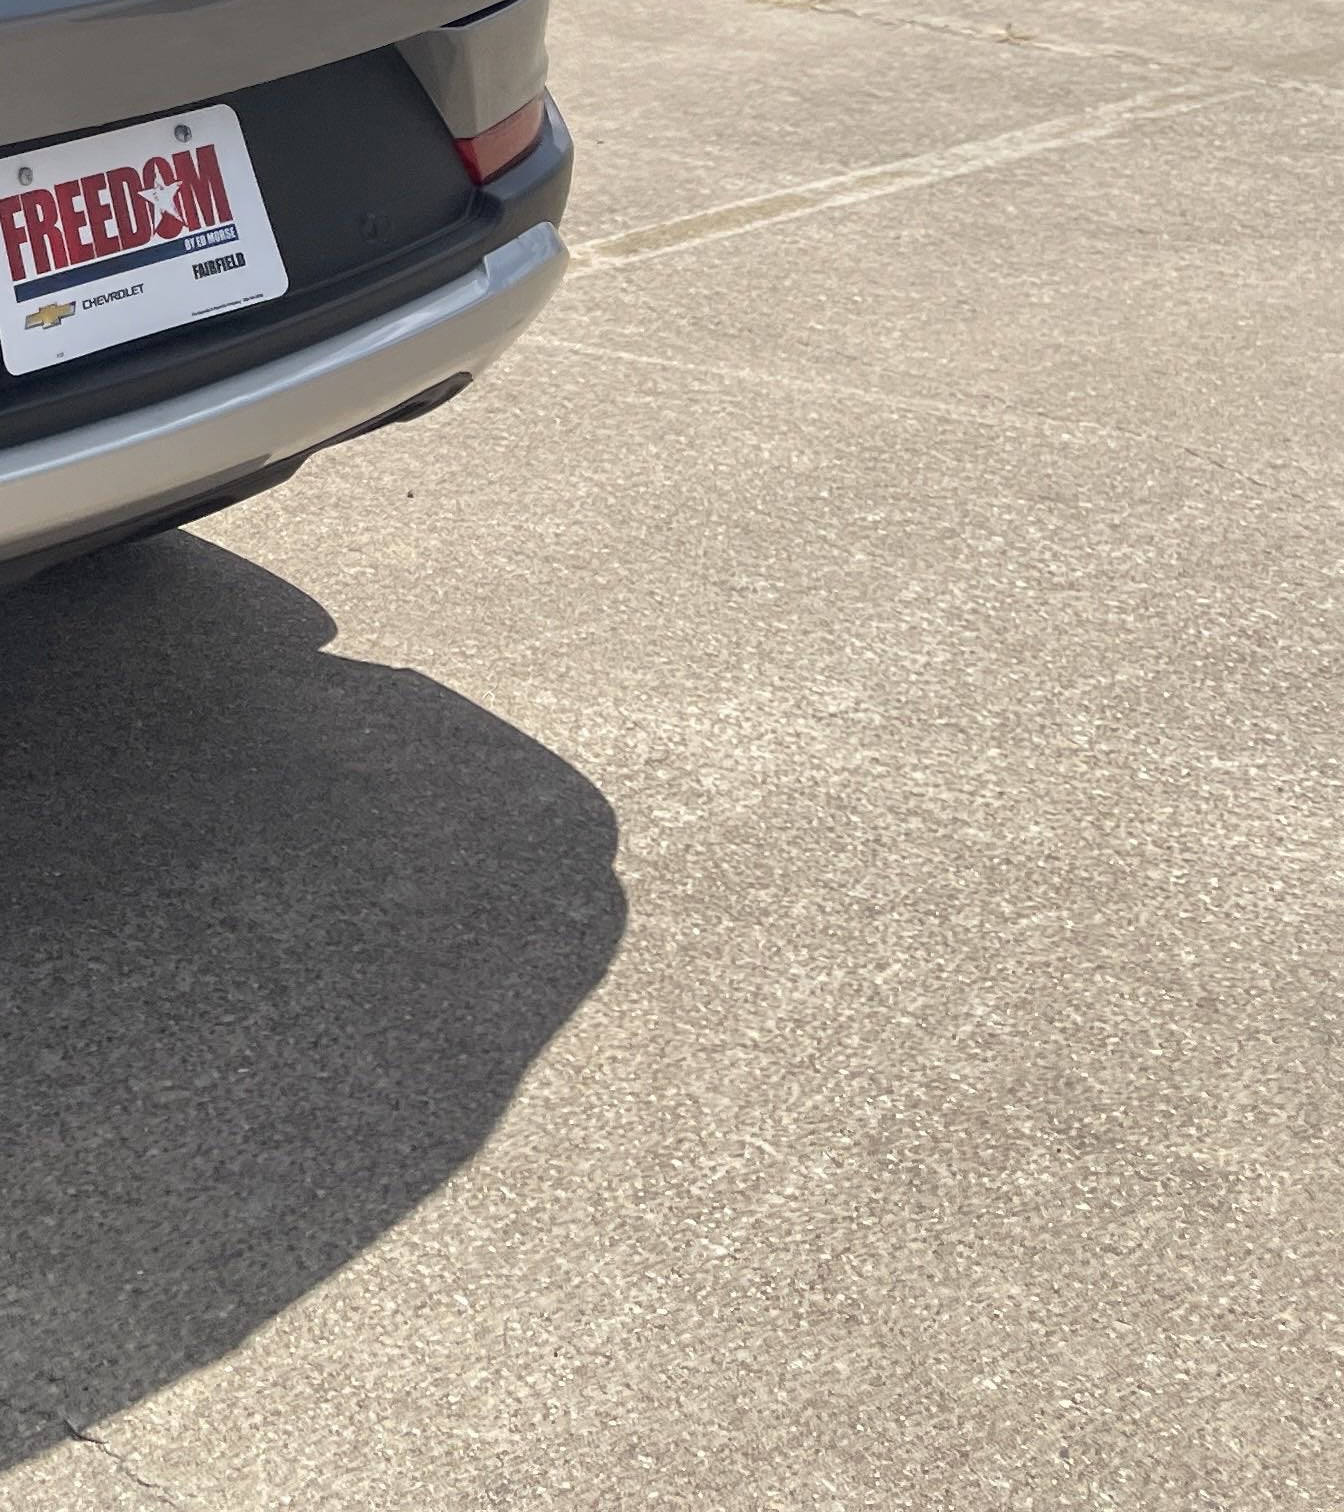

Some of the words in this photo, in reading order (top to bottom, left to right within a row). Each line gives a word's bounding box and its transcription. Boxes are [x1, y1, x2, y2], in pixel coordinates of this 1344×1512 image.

[207, 226, 237, 245] MORSE
[191, 252, 246, 280] FAIRFIELD
[81, 283, 145, 311] CHEVROLET
